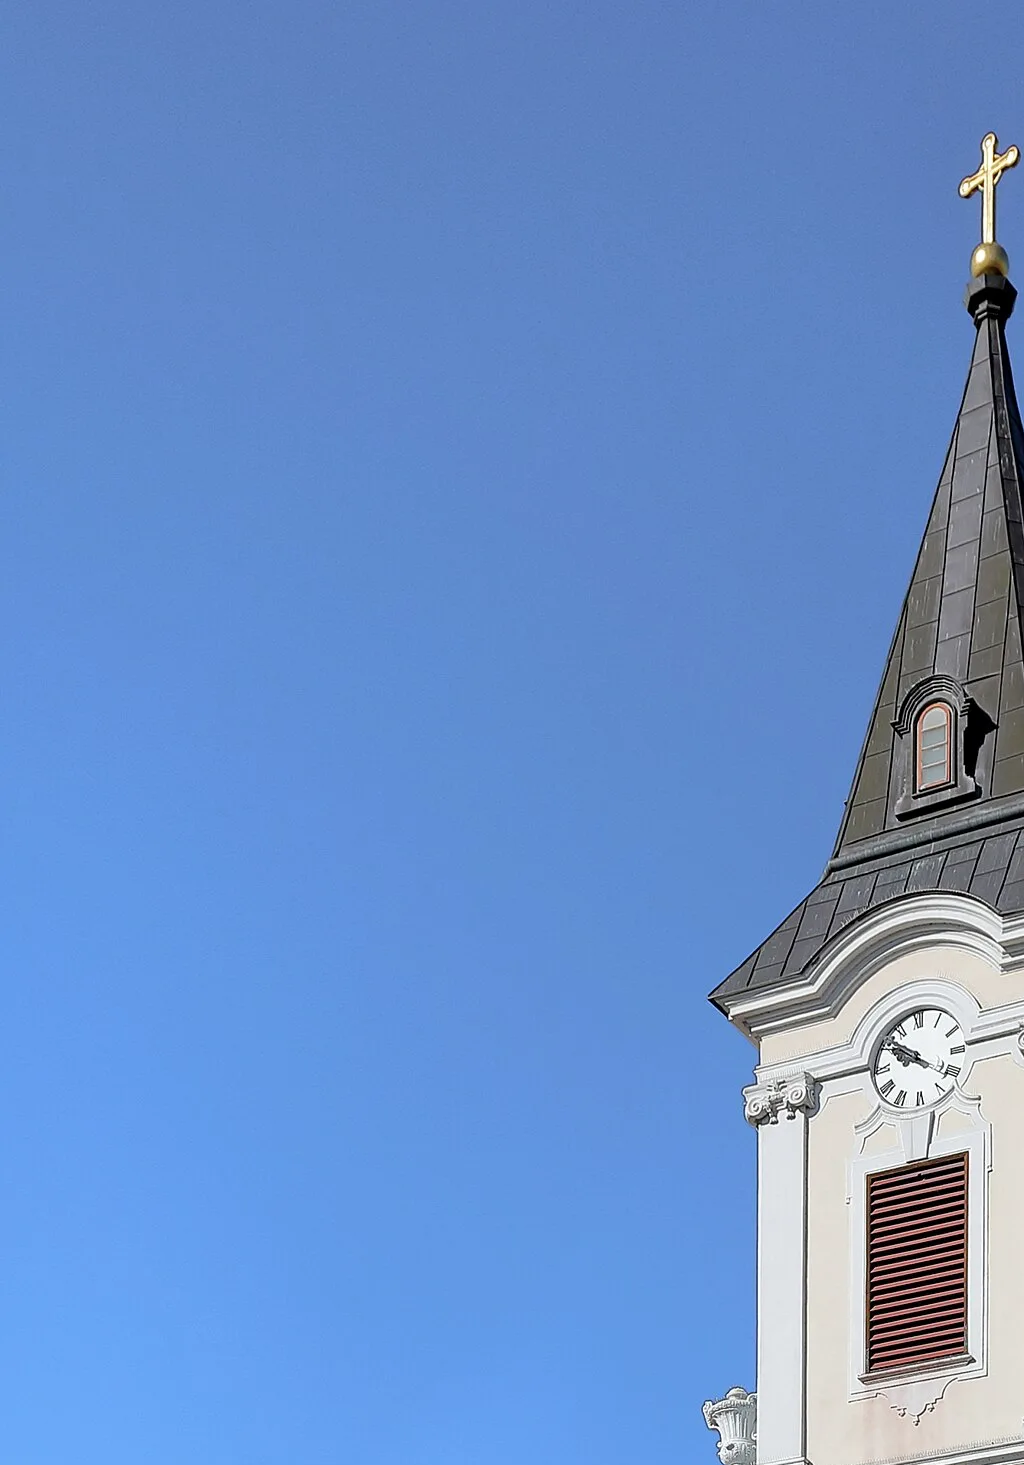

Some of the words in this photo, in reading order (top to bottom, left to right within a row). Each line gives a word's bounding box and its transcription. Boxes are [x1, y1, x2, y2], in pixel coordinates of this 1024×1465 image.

[913, 1011, 924, 1031] XII
[945, 1024, 959, 1038] II
[950, 1045, 966, 1055] III
